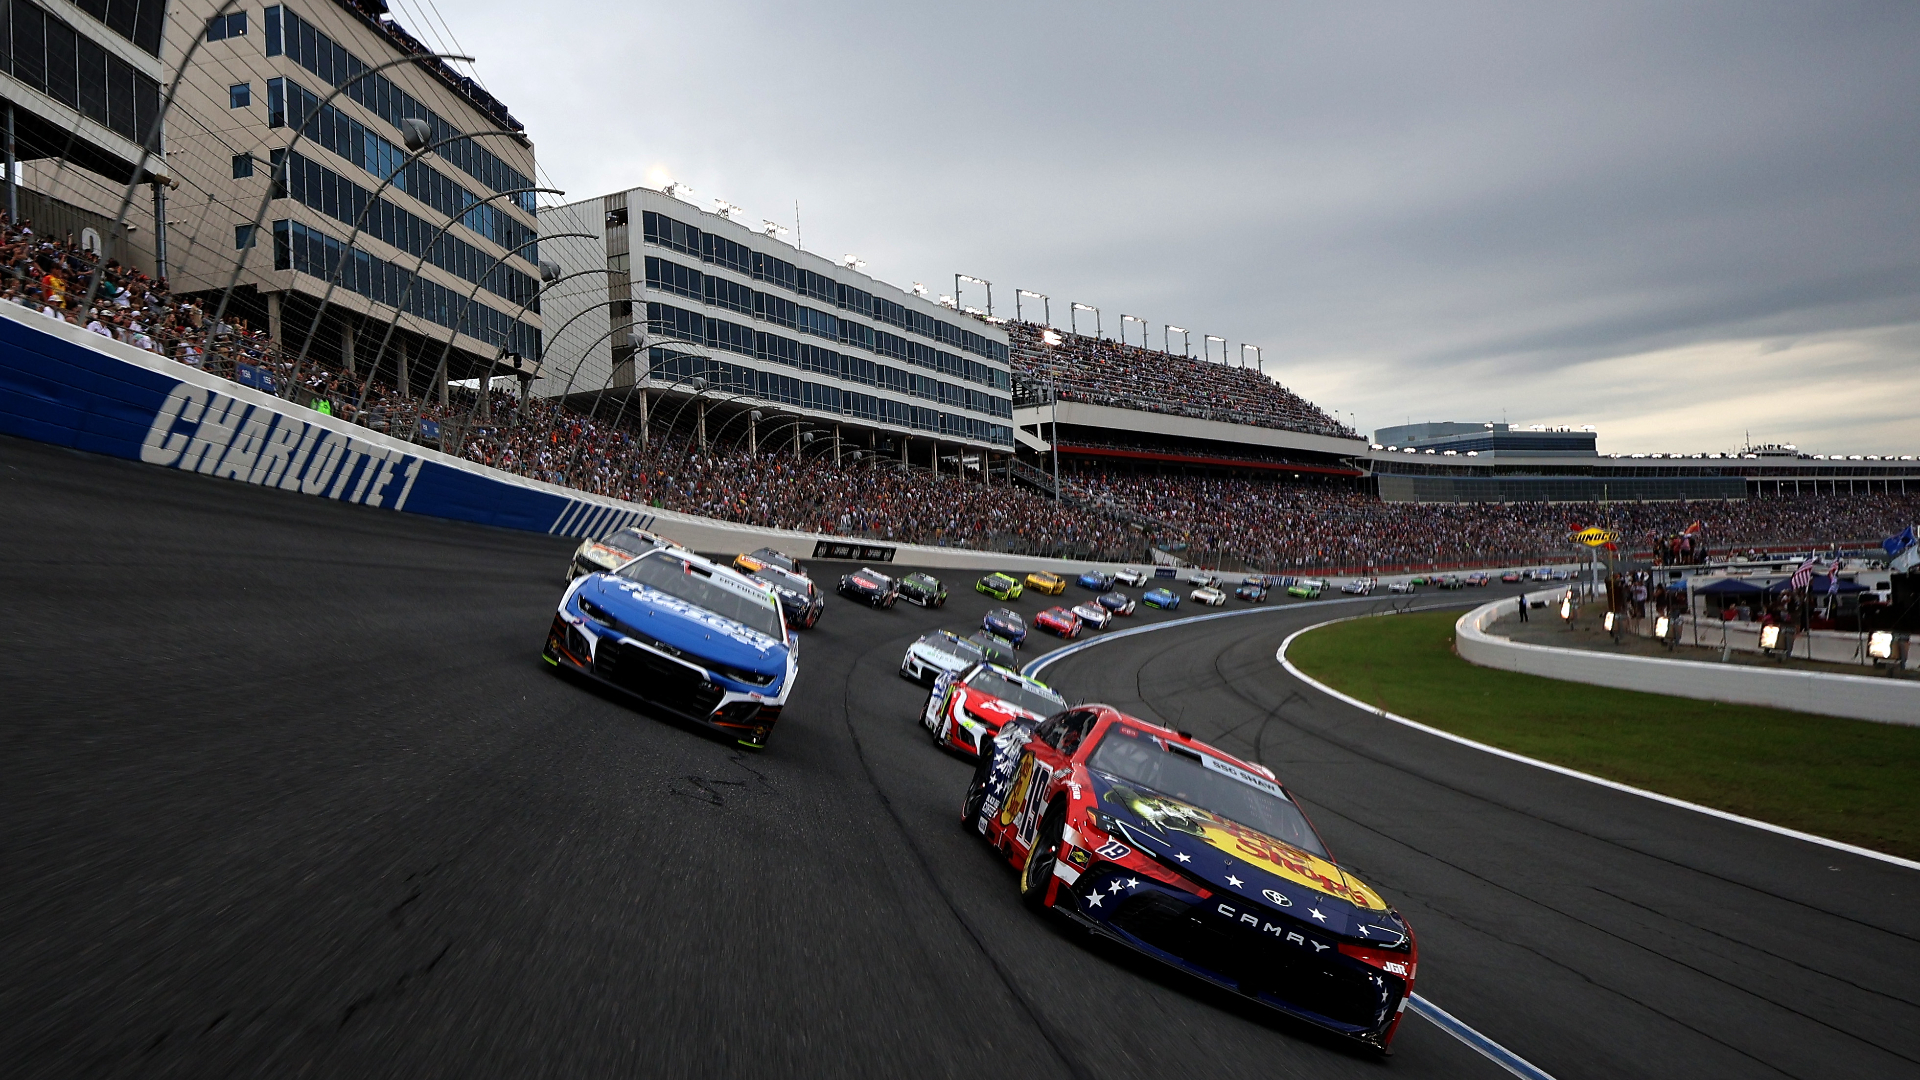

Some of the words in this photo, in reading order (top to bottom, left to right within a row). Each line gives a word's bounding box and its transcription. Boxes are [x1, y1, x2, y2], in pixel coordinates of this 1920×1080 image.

[140, 382, 405, 508] CHARLOTTE
[394, 456, 425, 511] 1
[1568, 532, 1619, 544] SUNOCO
[1212, 760, 1237, 776] SSG
[1239, 772, 1276, 792] SHAW
[1094, 838, 1132, 861] 19
[1217, 903, 1331, 953] CAMRY
[1382, 960, 1408, 977] JGR
